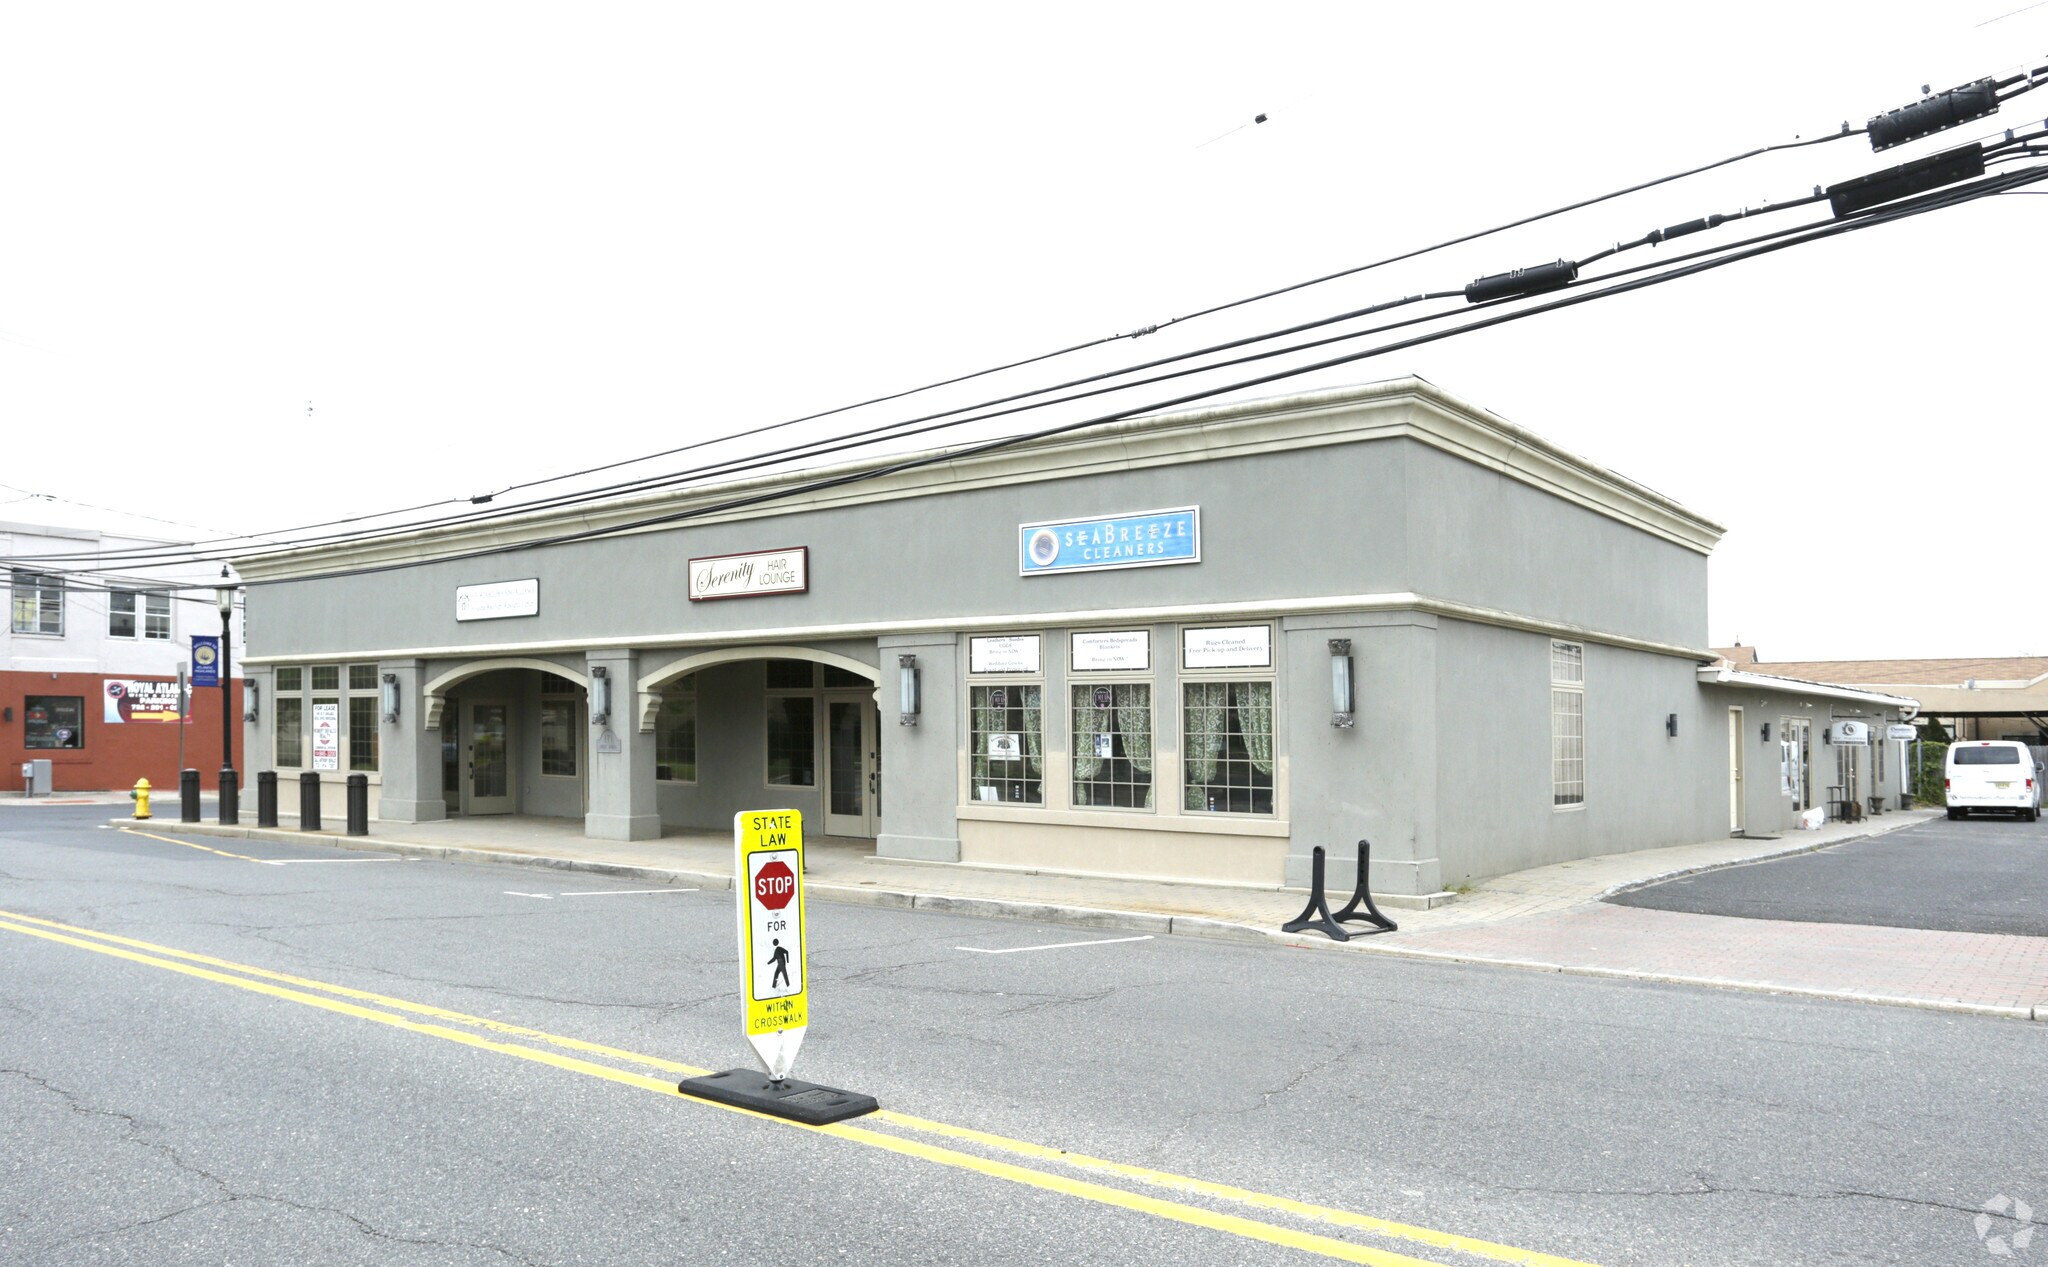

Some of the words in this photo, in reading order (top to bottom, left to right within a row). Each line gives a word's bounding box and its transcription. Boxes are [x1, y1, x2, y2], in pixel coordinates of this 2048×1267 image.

[1083, 541, 1164, 560] CLEANERS
[767, 558, 787, 571] HAIR
[696, 562, 754, 593] Serenity
[759, 571, 796, 586] LOUNGE
[1109, 636, 1138, 644] Bedspreads
[1238, 645, 1264, 653] Delivery
[127, 682, 155, 694] ROYAL
[139, 697, 178, 705] PARKING
[753, 815, 792, 831] STATE
[760, 833, 787, 847] LAW
[757, 875, 793, 896] STOP
[767, 920, 787, 932] FOR
[766, 1000, 794, 1014] WITHIN
[754, 1012, 803, 1029] CROSSWALK
